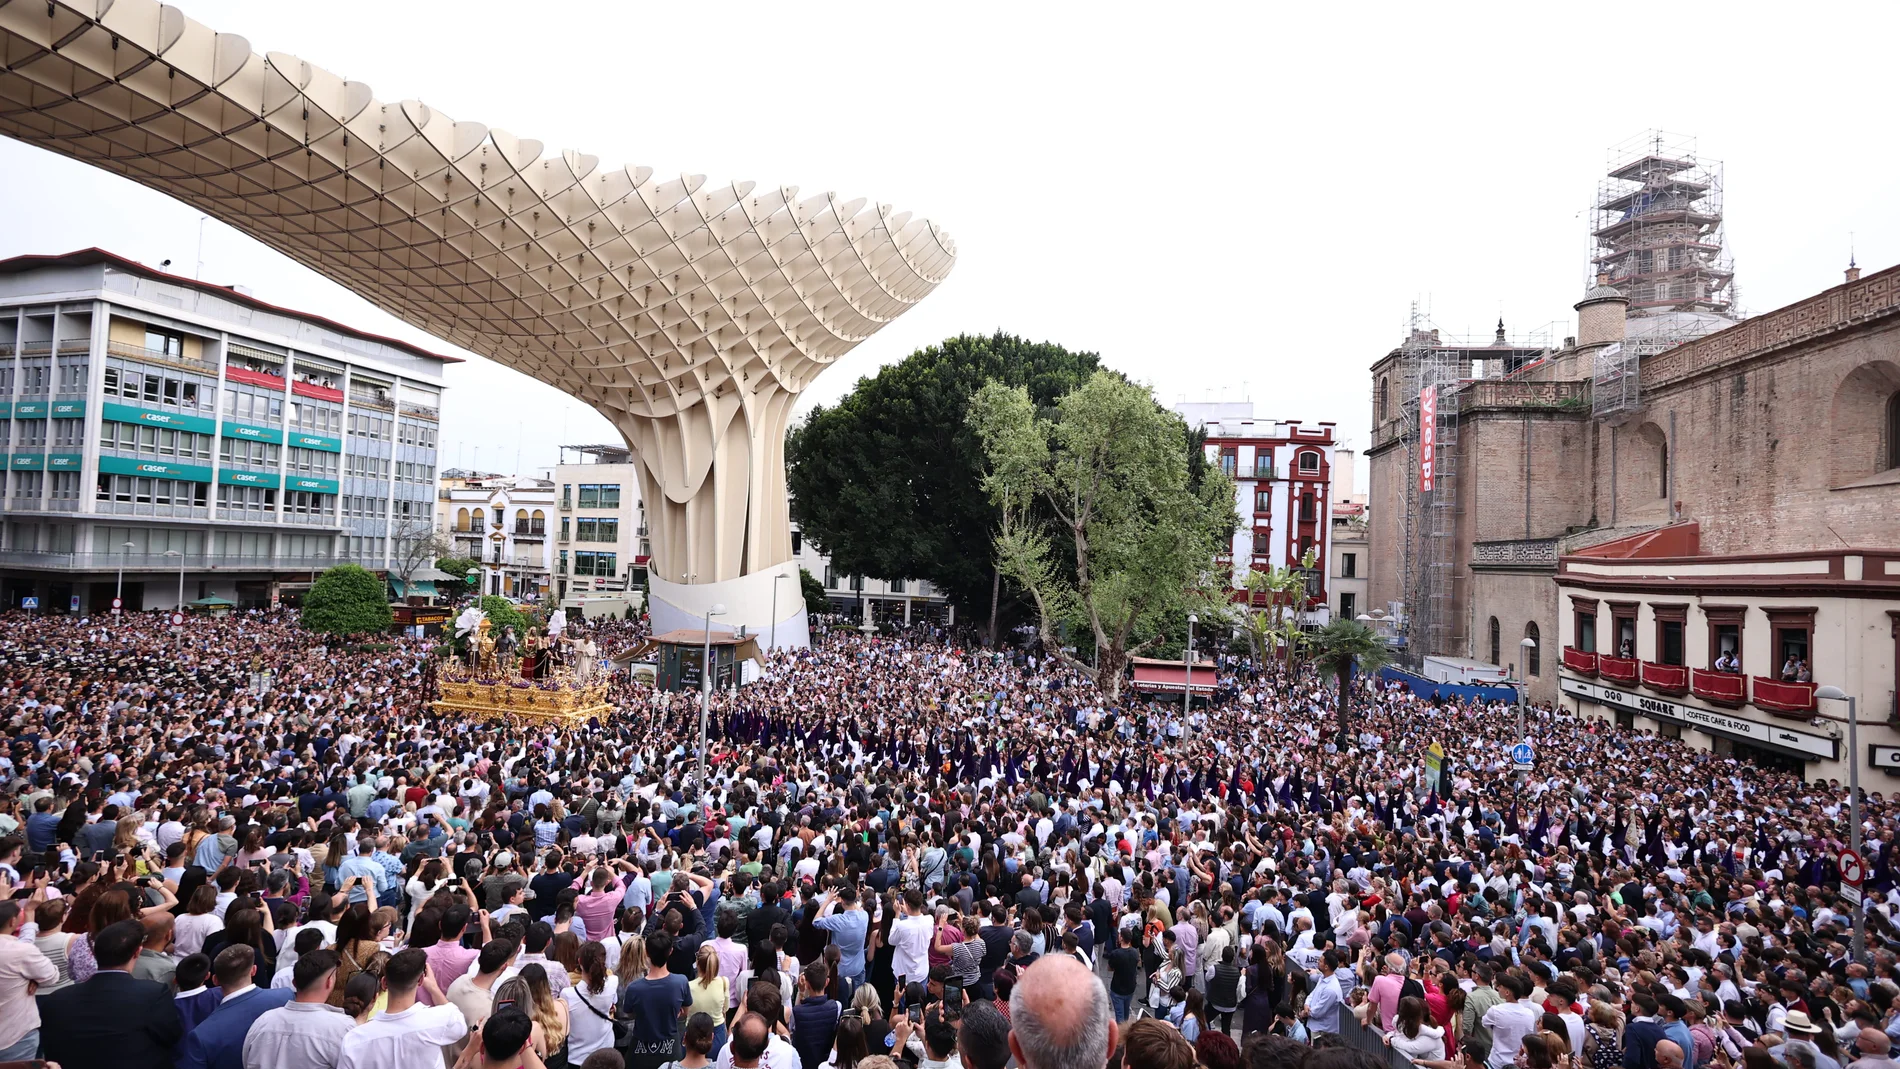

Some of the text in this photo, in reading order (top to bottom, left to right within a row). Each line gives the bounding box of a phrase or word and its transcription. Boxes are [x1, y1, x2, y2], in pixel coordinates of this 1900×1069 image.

[146, 413, 171, 423] caser
[239, 427, 261, 437] caser
[303, 437, 323, 446] caser
[1423, 385, 1432, 492] cyrespa
[142, 464, 167, 473] caser
[236, 473, 257, 482] caser
[301, 480, 320, 488] caser
[1639, 698, 1675, 716] SQUARE
[1711, 716, 1726, 727] CAKE
[1728, 720, 1733, 728] &
[1734, 721, 1750, 732] FOOD
